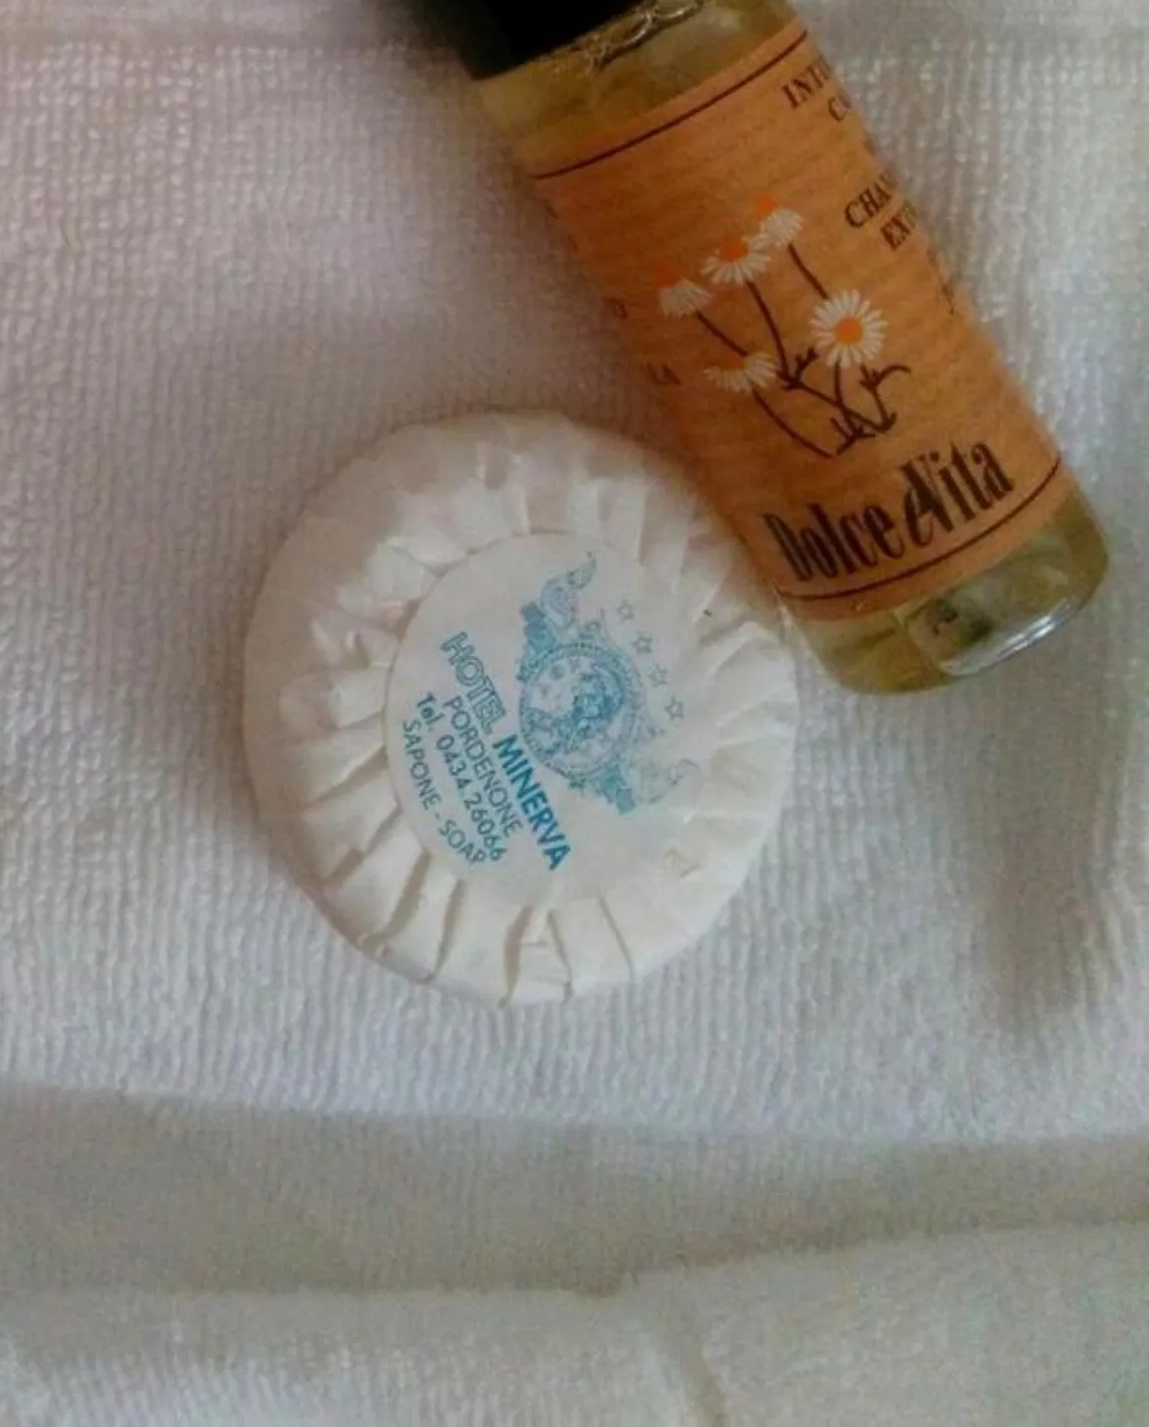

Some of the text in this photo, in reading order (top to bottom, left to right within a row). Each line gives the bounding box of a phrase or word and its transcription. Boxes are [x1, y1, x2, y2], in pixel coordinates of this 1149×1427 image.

[403, 719, 442, 811] SAPONE
[438, 819, 487, 864] SOAP
[440, 631, 571, 871] HOTEL MINERVA
[442, 695, 524, 837] PORDENONE
